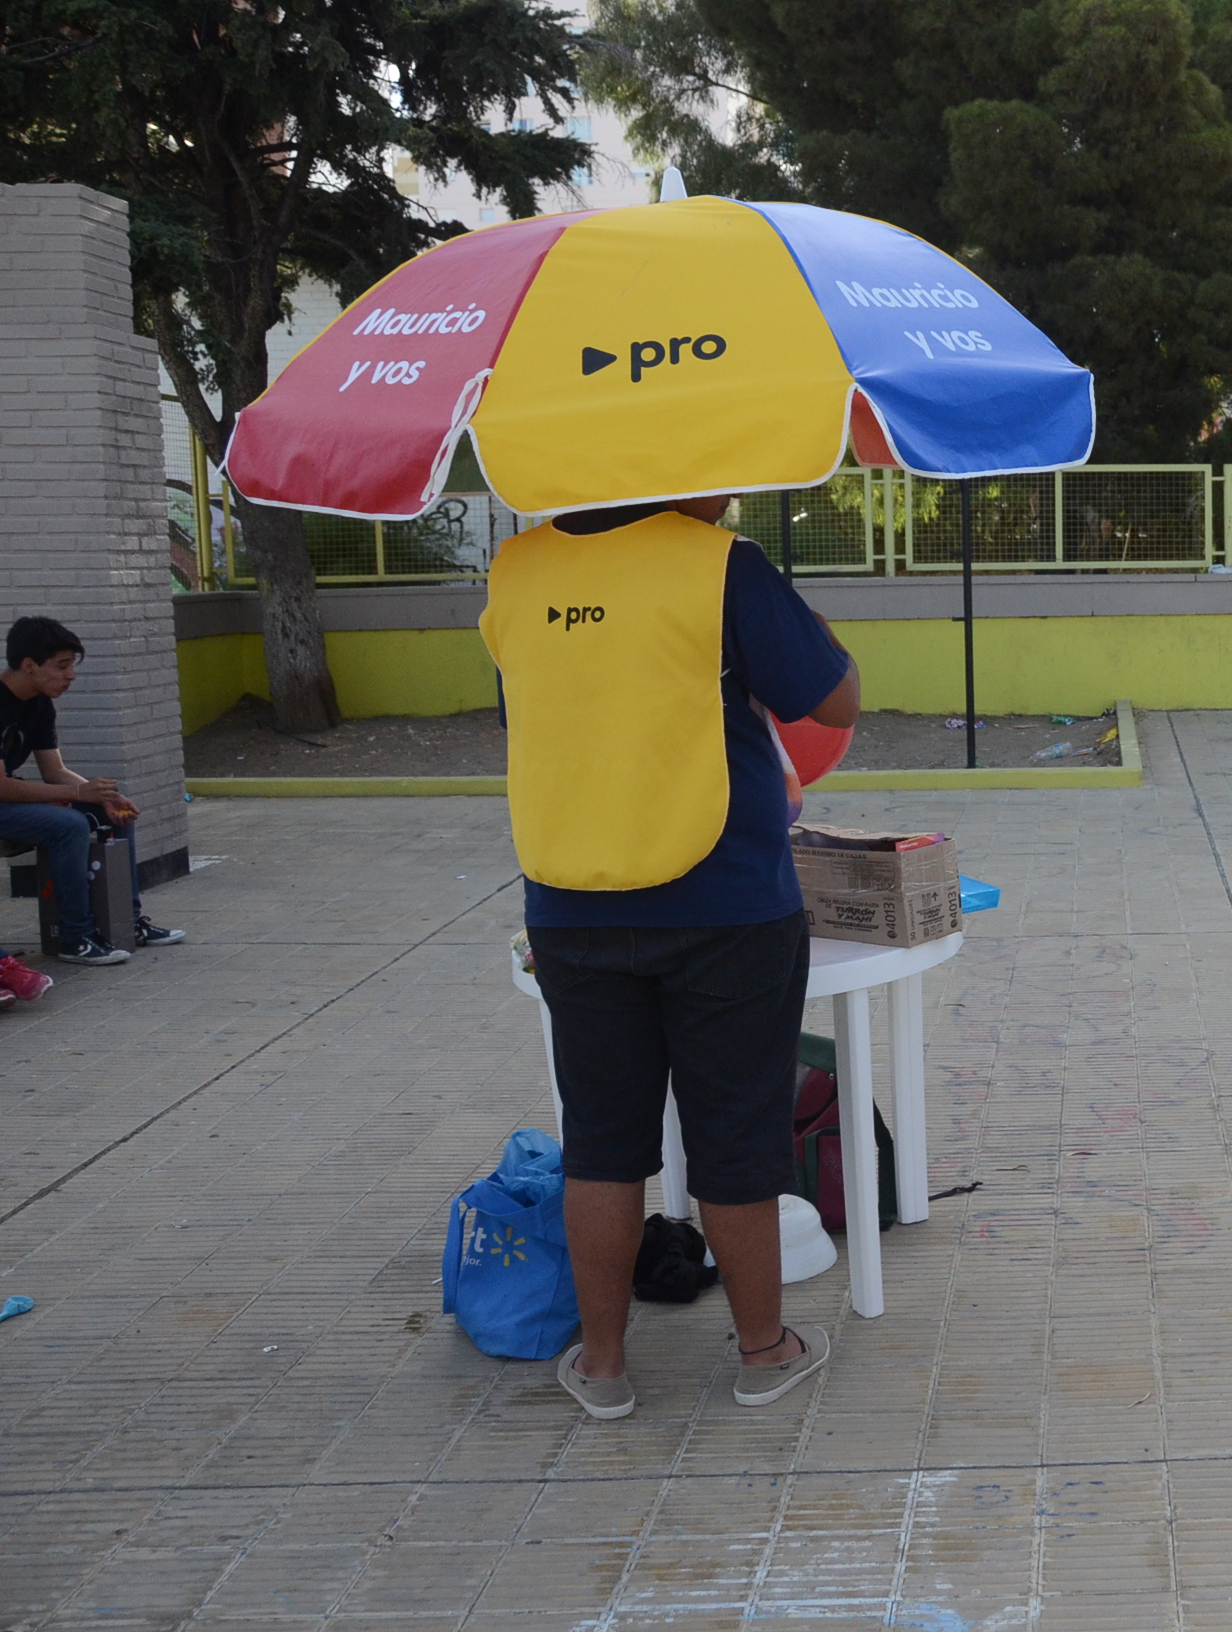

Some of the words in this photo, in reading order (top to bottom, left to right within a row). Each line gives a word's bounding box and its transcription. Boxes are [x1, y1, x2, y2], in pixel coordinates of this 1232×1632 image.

[834, 280, 979, 309] Mauricio
[352, 302, 486, 336] Mauricio
[630, 333, 727, 384] pro
[903, 330, 934, 360] y
[930, 330, 993, 352] vos
[338, 360, 372, 393] y
[370, 360, 427, 385] vos
[565, 605, 605, 632] pro
[845, 852, 867, 860] CAJAS
[883, 902, 897, 930] 4013
[947, 890, 958, 918] 4013
